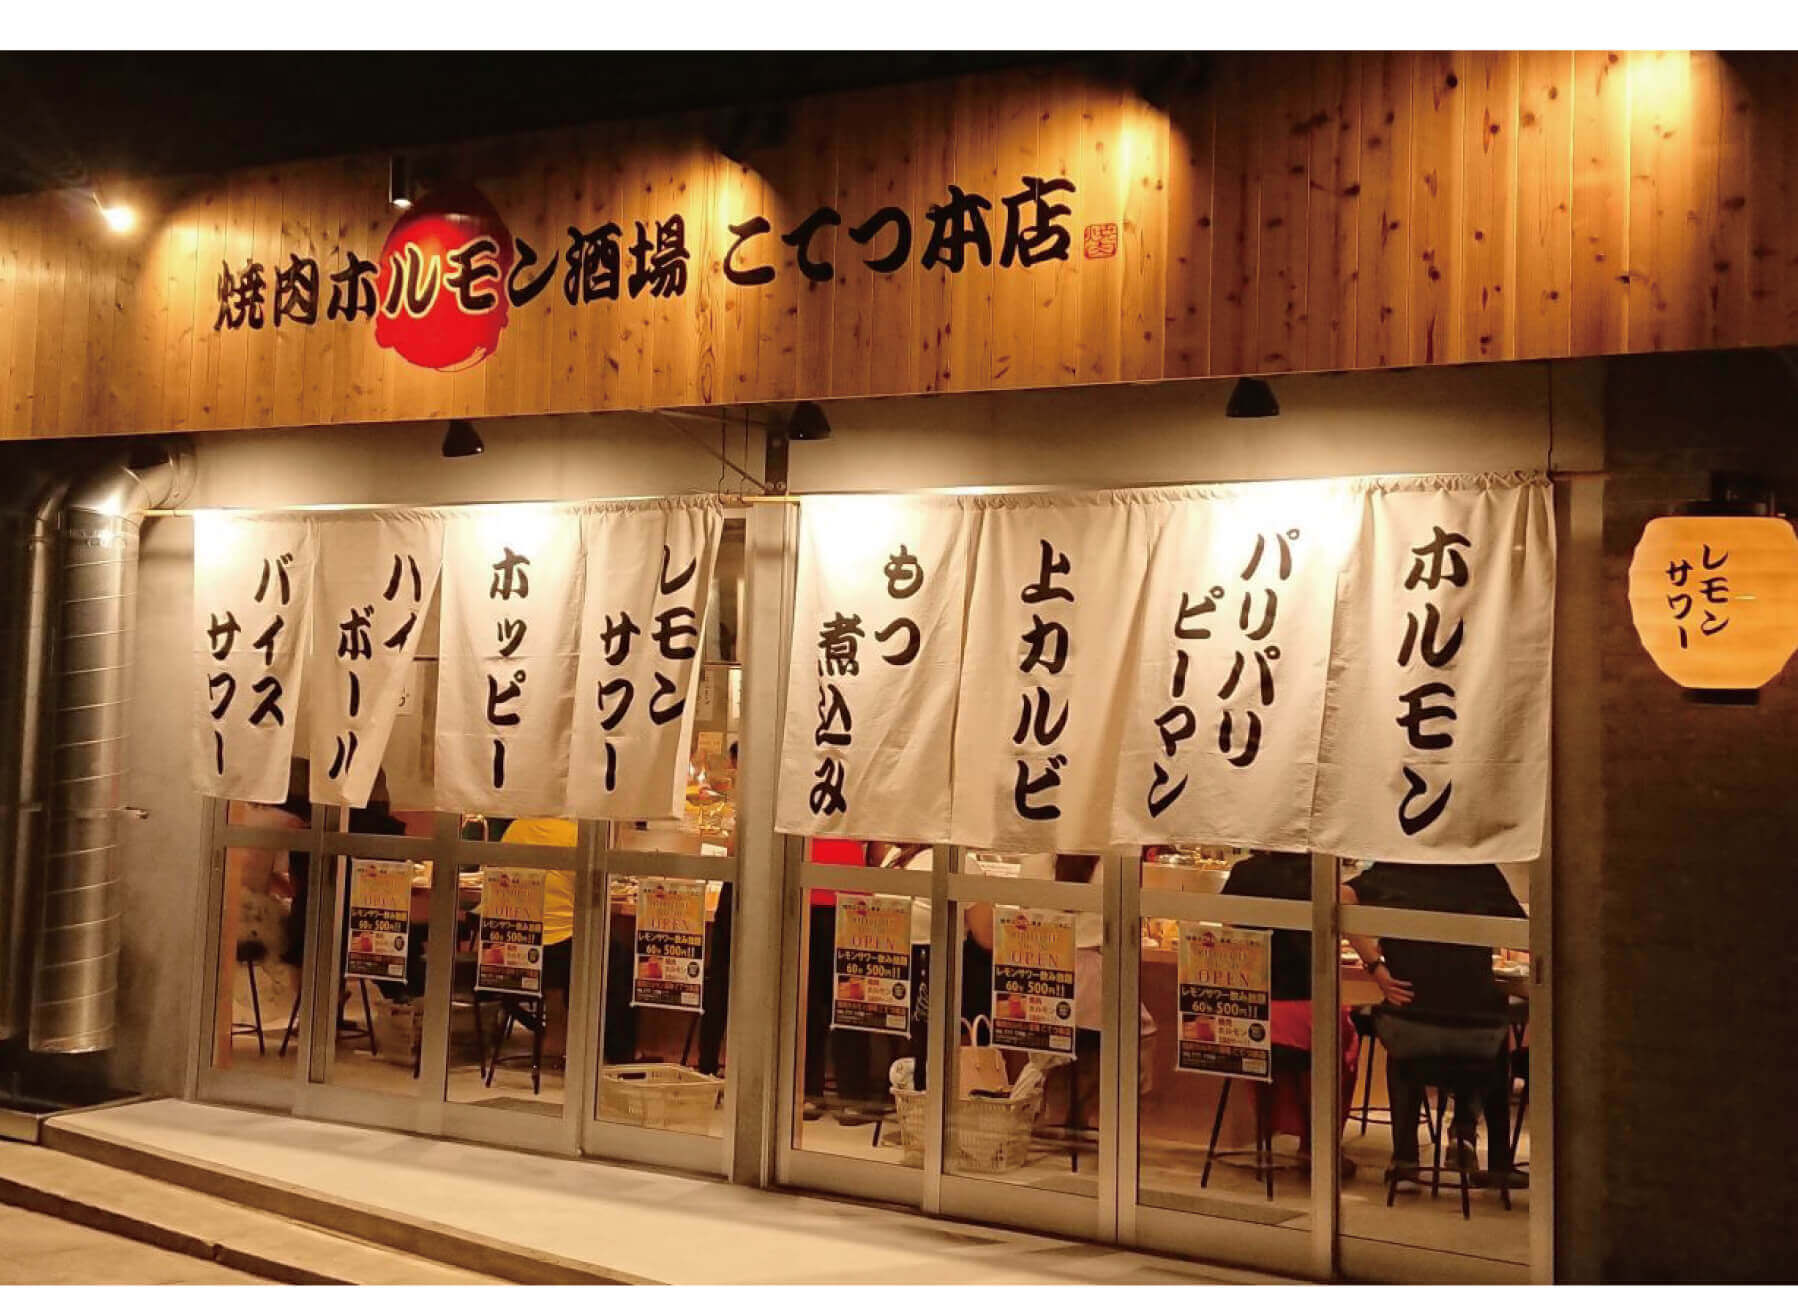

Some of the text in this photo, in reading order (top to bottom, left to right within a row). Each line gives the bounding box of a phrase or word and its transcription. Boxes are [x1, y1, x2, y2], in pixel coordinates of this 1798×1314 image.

[214, 176, 1076, 332] 焼肉ホルモン酒場 こてつ本店
[250, 553, 292, 727] バイス
[383, 554, 421, 651] ハイ
[489, 547, 530, 789] ホッピー
[649, 545, 697, 725] レモン
[874, 544, 923, 666] もつ
[1217, 528, 1299, 767] パリパリ
[1666, 559, 1693, 649] サワー
[1700, 544, 1729, 636] レモン
[207, 611, 241, 774] サワー
[329, 605, 374, 779] ボール
[598, 611, 640, 792] サワー
[809, 612, 864, 815] 煮込み
[1013, 539, 1075, 820] 上カルビ
[1147, 585, 1225, 818] ピーマン
[1396, 526, 1471, 835] ホルモン
